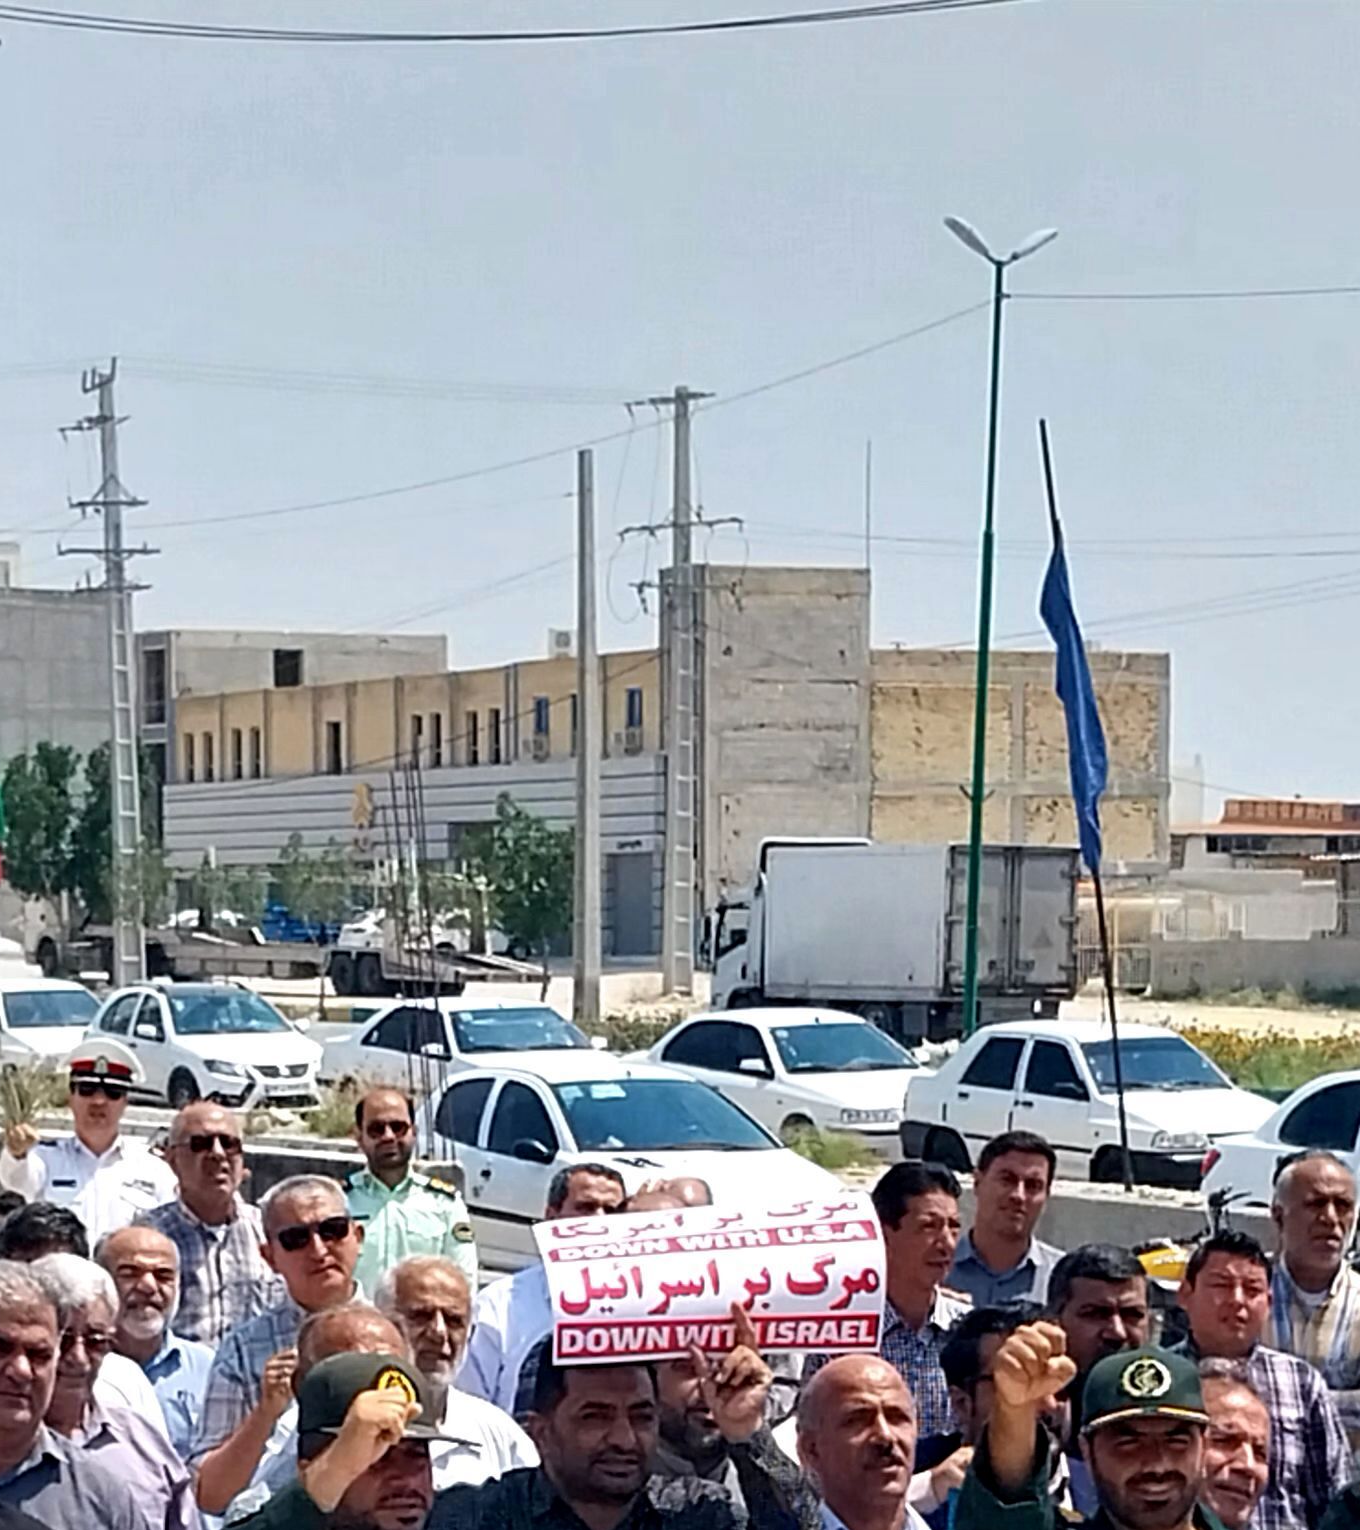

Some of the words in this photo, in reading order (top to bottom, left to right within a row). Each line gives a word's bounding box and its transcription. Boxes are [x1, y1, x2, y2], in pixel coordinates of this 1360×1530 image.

[767, 1201, 858, 1220] مرگ
[557, 1239, 669, 1261] DOWN
[675, 1228, 771, 1252] WITH
[778, 1221, 869, 1245] U.S.A
[559, 1258, 721, 1316] اسرائیل
[741, 1266, 772, 1311] بر
[786, 1252, 881, 1311] مرگ
[560, 1325, 670, 1354] DOWN
[677, 1322, 761, 1349] WIT
[764, 1319, 875, 1345] ISRAEL
